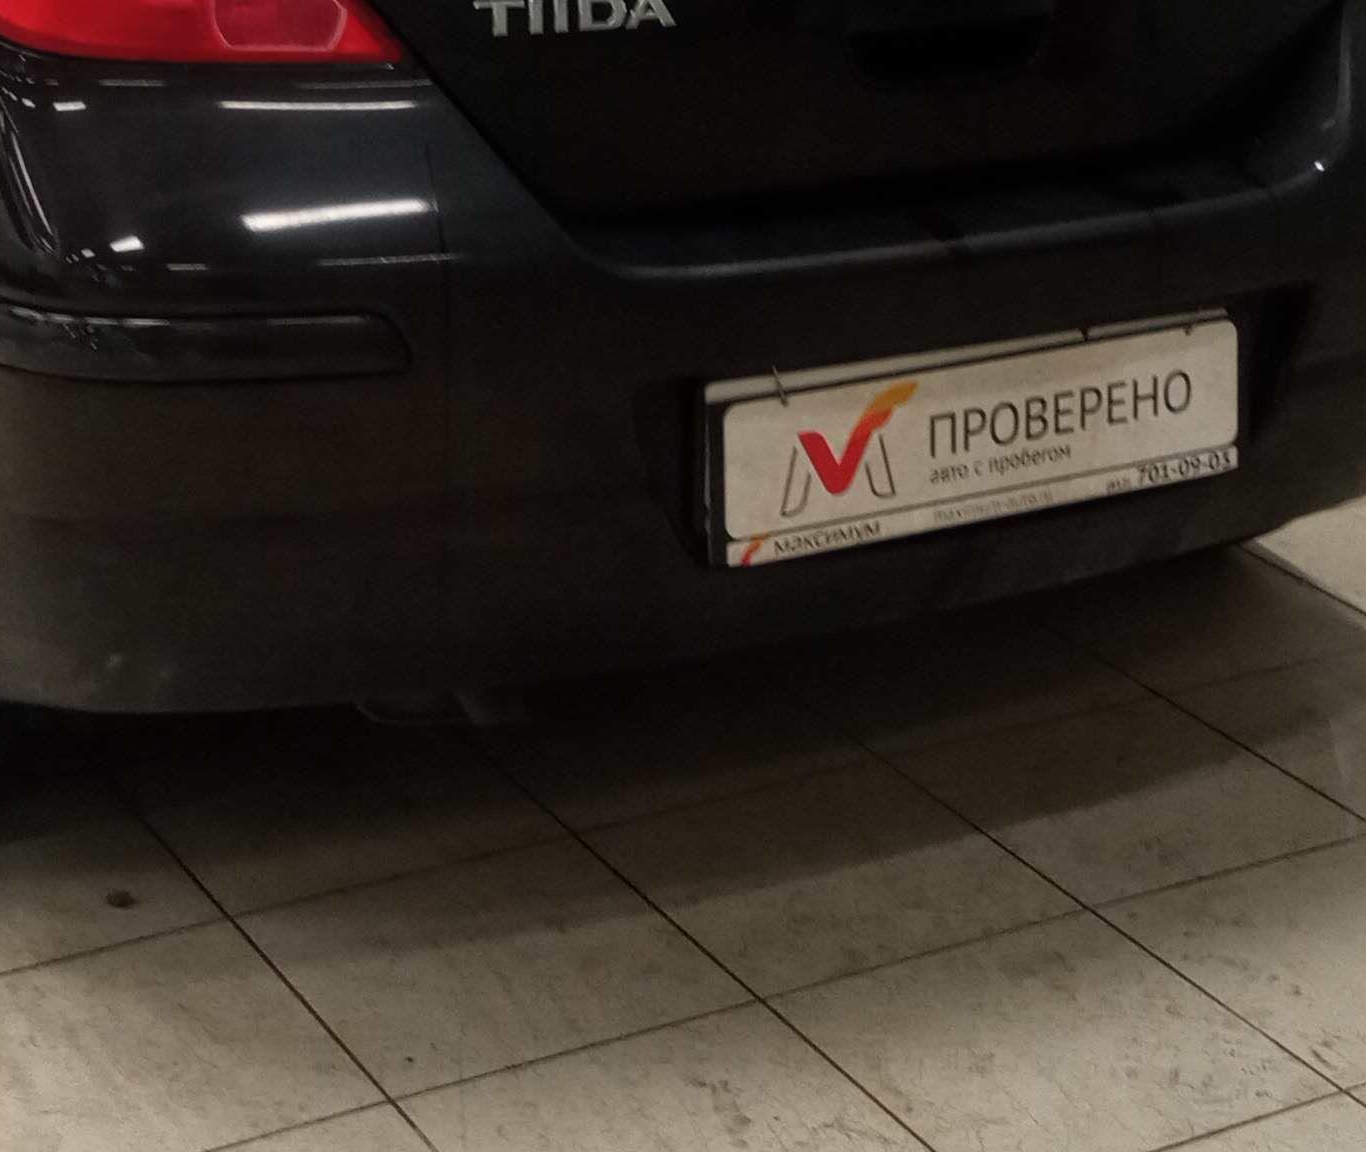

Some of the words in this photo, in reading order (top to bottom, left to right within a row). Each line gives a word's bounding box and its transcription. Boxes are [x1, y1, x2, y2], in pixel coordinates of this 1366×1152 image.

[929, 368, 1192, 459] ПРОВЕРЕНО
[930, 463, 969, 484] авто
[974, 459, 983, 476] с
[989, 445, 1071, 476] пробегом
[774, 520, 880, 555] МАКСИМУМ
